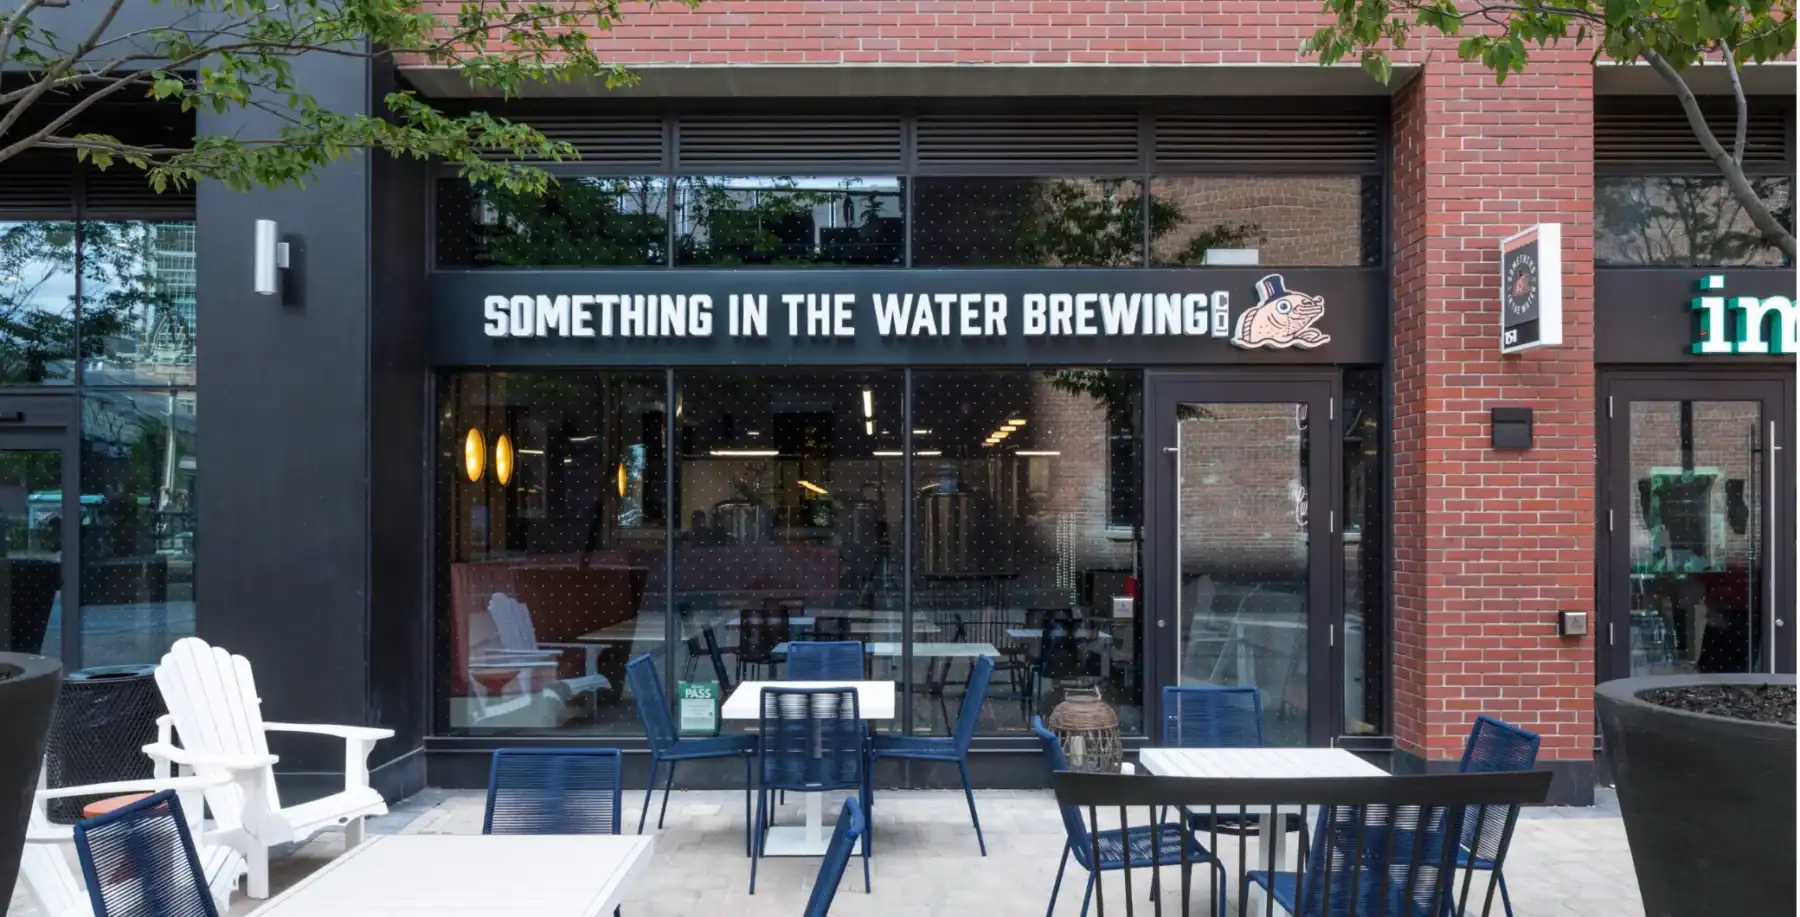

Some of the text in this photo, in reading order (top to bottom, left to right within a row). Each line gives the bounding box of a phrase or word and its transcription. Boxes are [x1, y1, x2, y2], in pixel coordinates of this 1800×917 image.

[484, 293, 1208, 337] SOMETHING IN THE WATER BREWING
[685, 688, 712, 698] PASS
